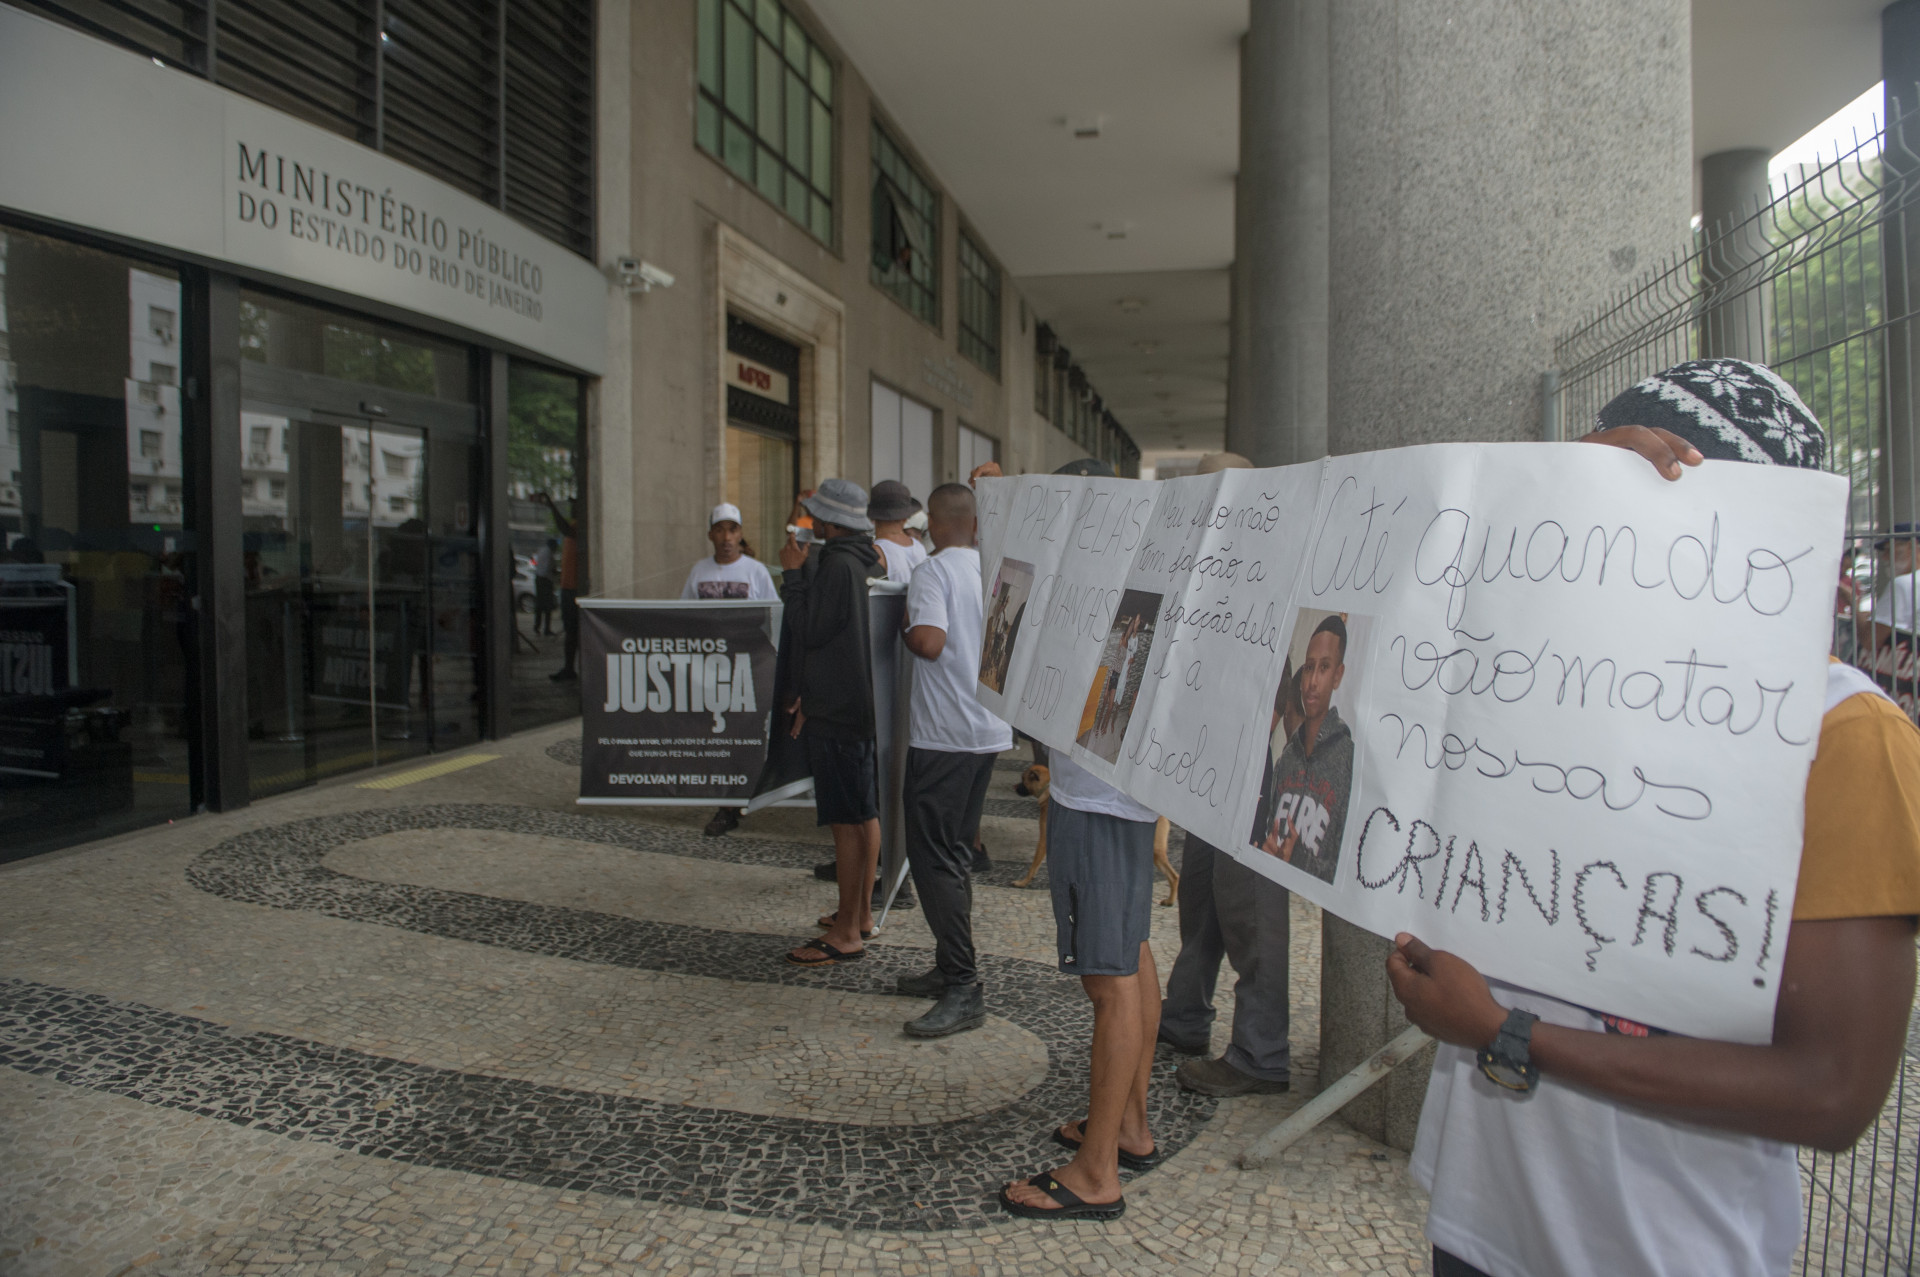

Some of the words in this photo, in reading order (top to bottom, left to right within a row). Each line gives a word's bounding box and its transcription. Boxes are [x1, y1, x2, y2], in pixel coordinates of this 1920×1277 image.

[237, 140, 448, 252] MINISTÉRIO
[458, 226, 543, 295] PÚBLICO
[238, 190, 278, 230] DO
[289, 207, 385, 263] ESTADO
[394, 242, 422, 275] DO
[429, 255, 459, 289] RIO
[464, 269, 484, 299] DE
[488, 280, 543, 323] JANEIRO
[1017, 484, 1071, 543] PAZ
[1076, 487, 1150, 557] PELAS
[1236, 490, 1280, 533] não
[1246, 560, 1267, 582] a
[621, 638, 728, 653] QUEREMOS
[1031, 574, 1118, 650] CRIANÇAS
[1234, 601, 1275, 653] dele
[604, 652, 757, 733] JUSTIÇA
[1186, 660, 1202, 691] a
[1391, 629, 1549, 703] vão
[1552, 647, 1810, 746] matar
[608, 773, 677, 785] DEVOLVAM
[679, 774, 707, 785] MEU
[710, 774, 748, 786] FILHO
[1379, 713, 1712, 820] nossas
[1355, 806, 1779, 989] CRIANÇAS!
